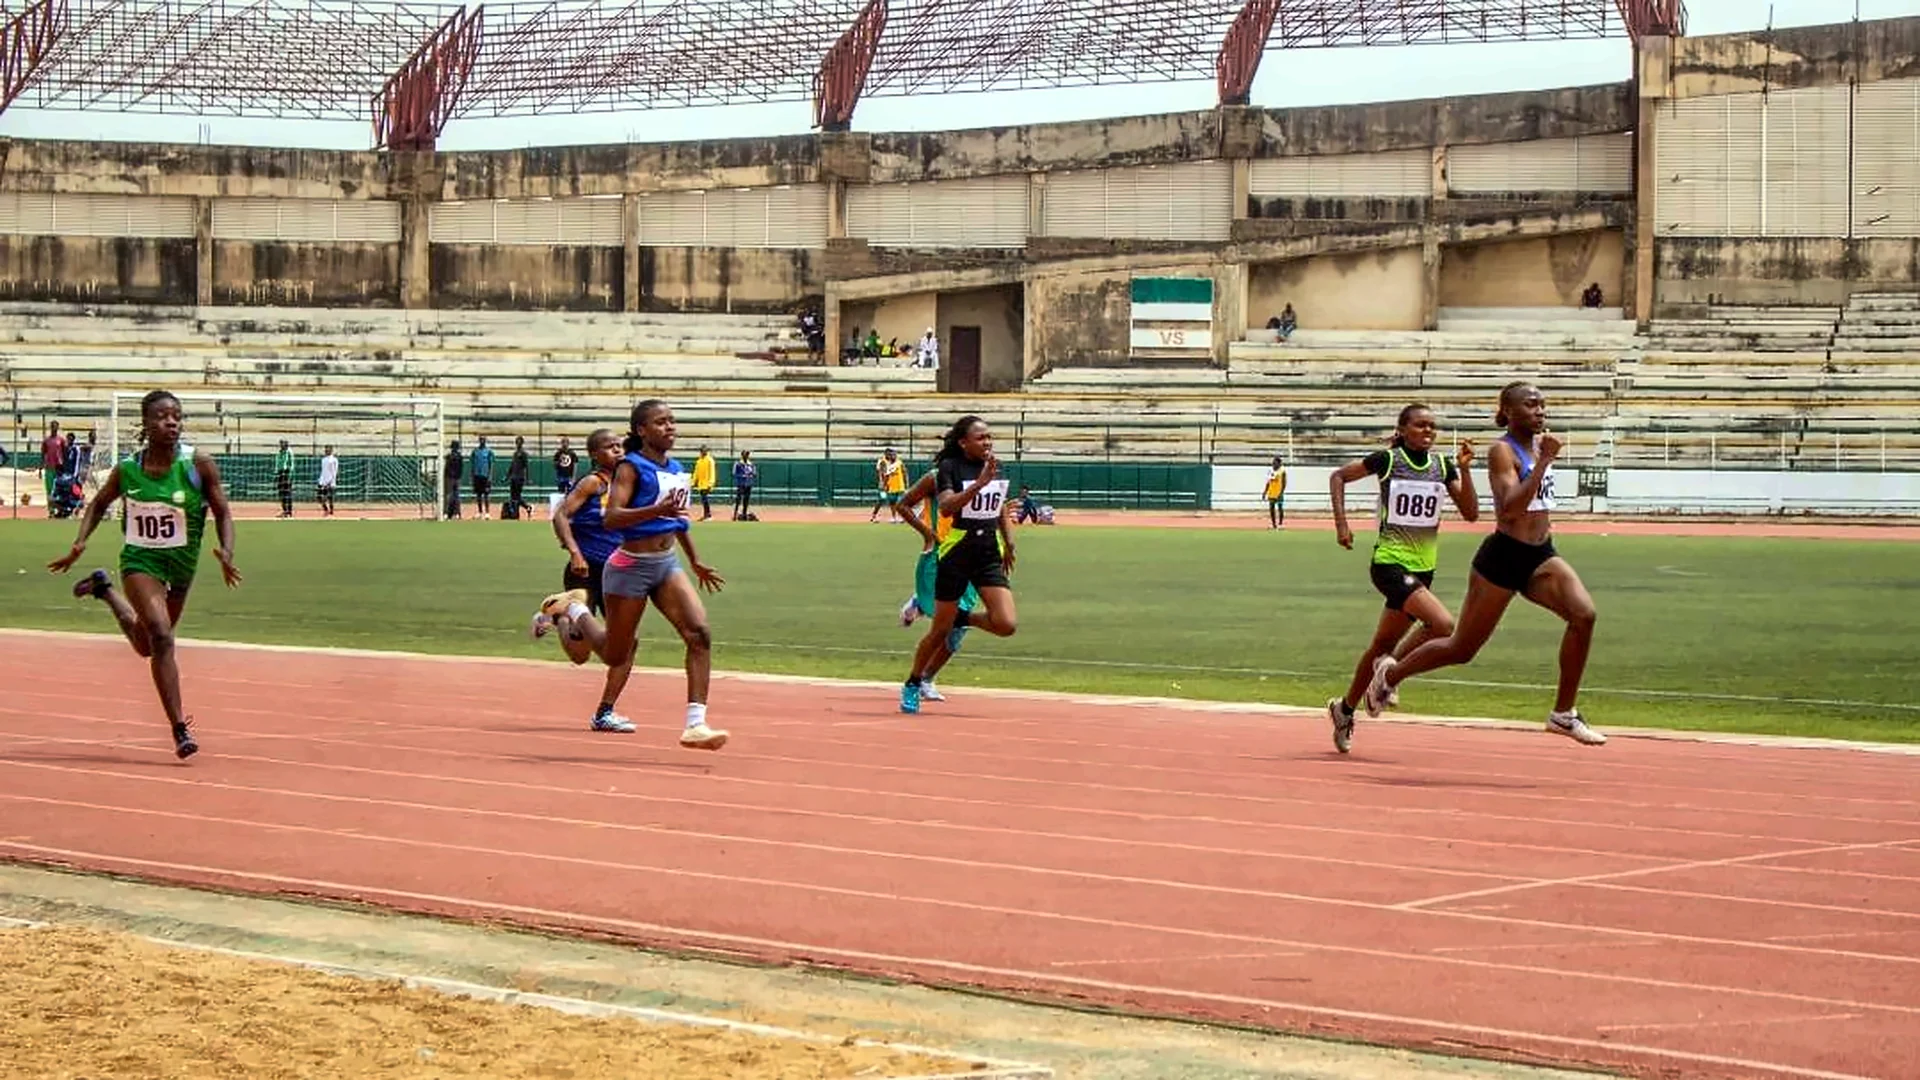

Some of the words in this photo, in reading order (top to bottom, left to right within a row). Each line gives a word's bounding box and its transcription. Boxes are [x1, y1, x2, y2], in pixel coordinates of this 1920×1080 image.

[1160, 331, 1185, 346] VS
[971, 491, 1002, 512] 016
[1395, 493, 1438, 518] 089
[134, 514, 175, 539] 105
